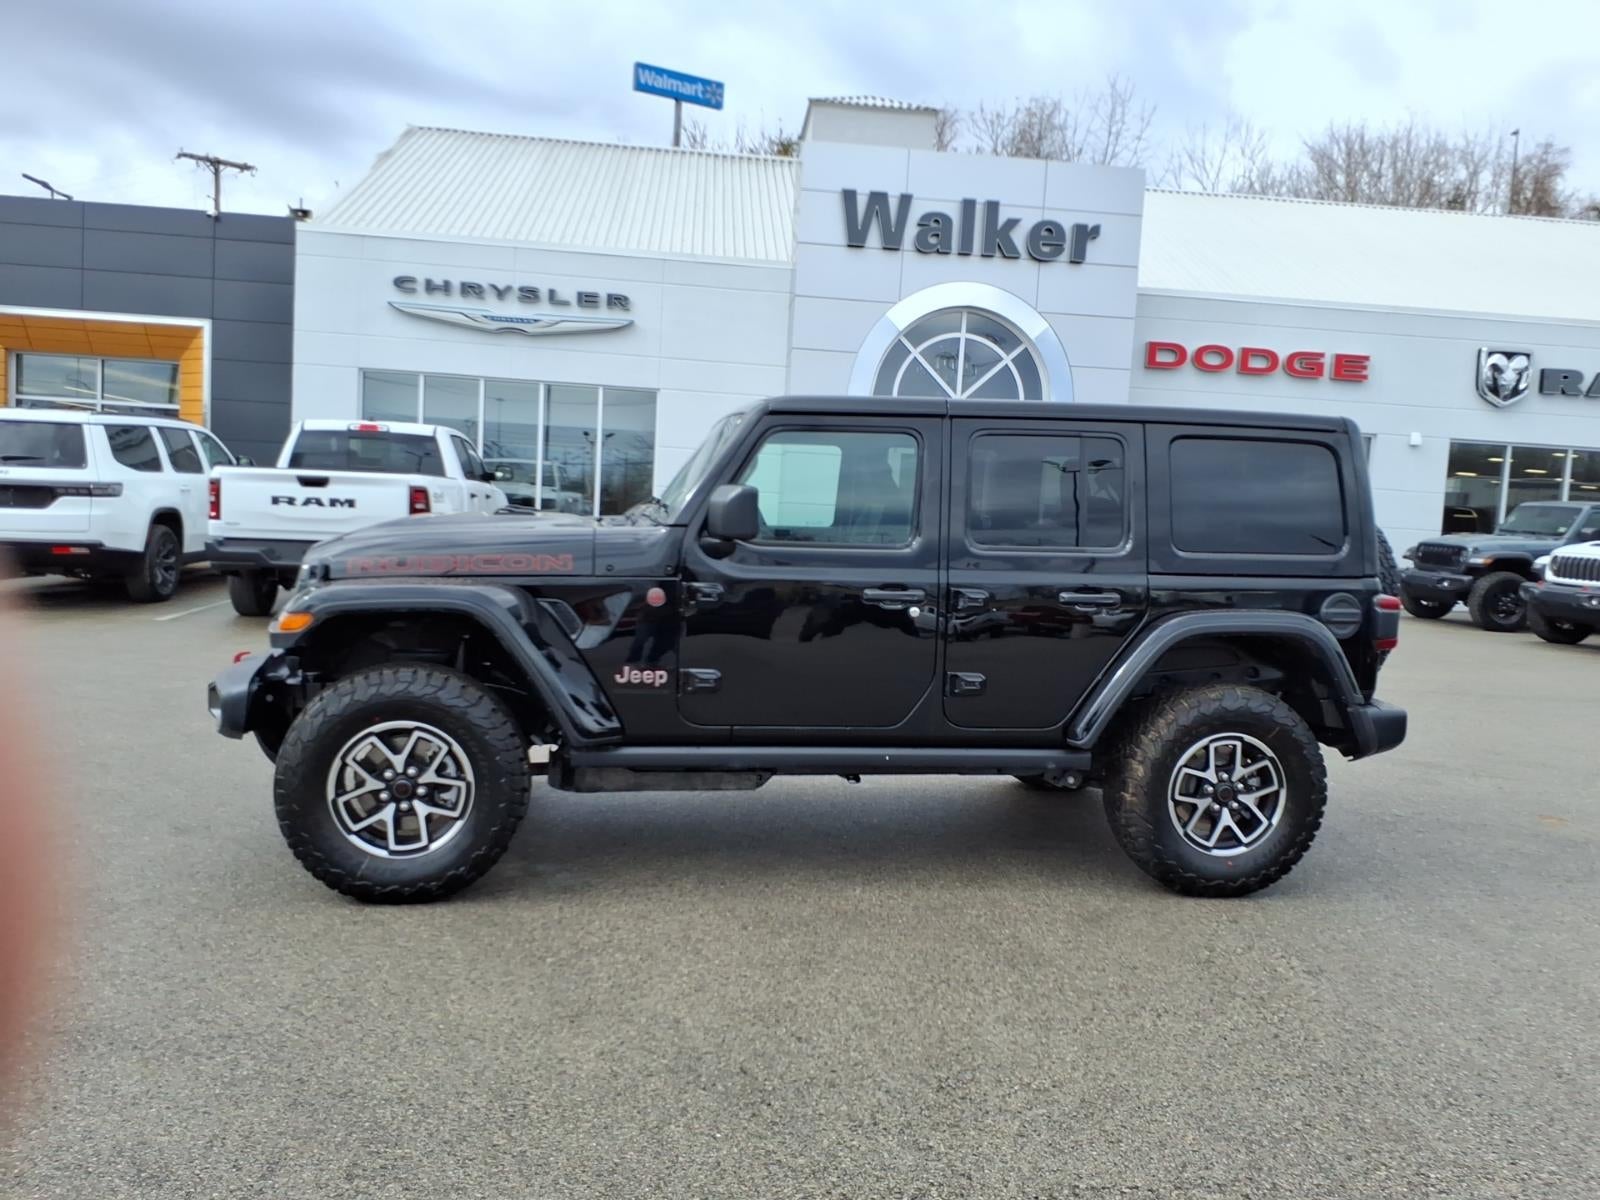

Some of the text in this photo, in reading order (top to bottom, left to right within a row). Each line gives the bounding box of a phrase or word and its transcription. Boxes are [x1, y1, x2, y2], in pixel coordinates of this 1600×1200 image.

[638, 67, 705, 98] Walmart
[842, 188, 1101, 264] Walker
[393, 275, 631, 311] CHRYSLER
[1145, 341, 1370, 382] DODGE
[271, 495, 356, 508] RAM
[347, 554, 574, 575] RUBICON
[614, 666, 668, 687] Jeep
